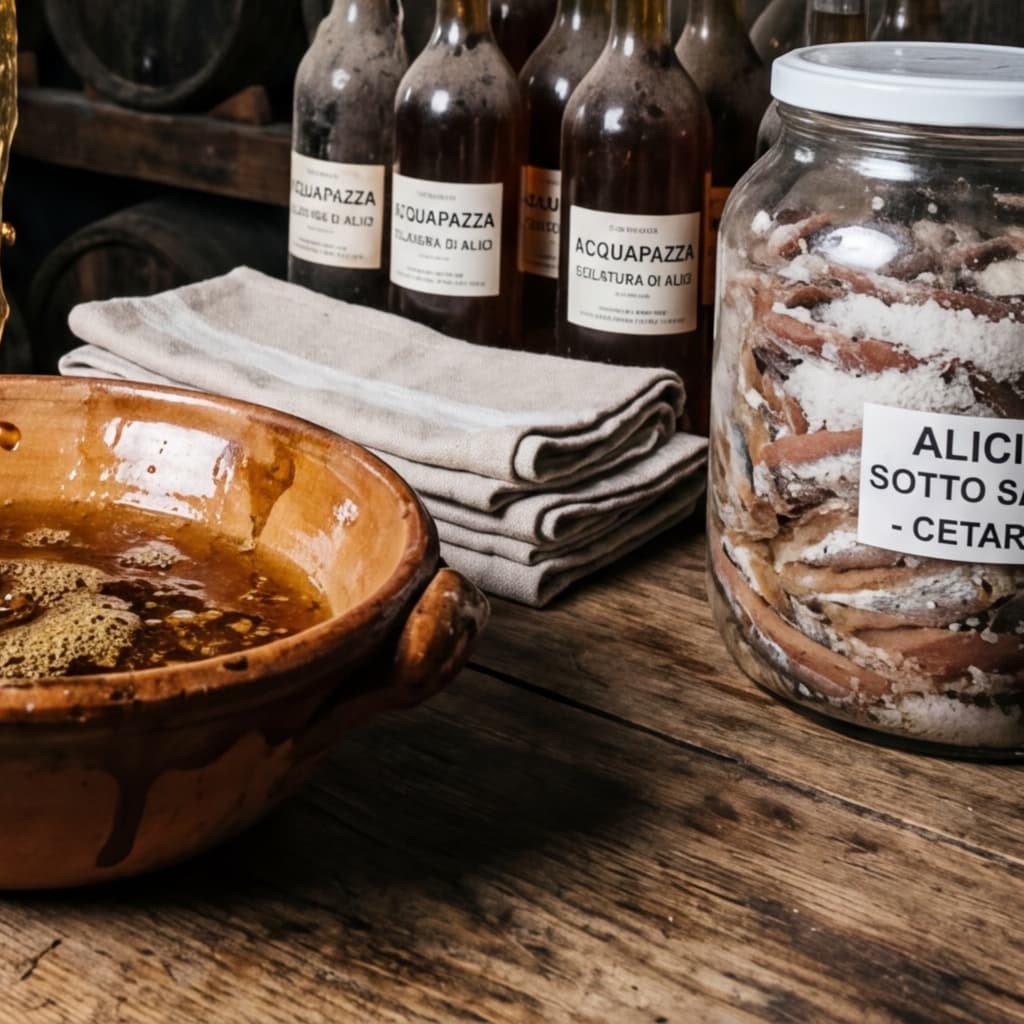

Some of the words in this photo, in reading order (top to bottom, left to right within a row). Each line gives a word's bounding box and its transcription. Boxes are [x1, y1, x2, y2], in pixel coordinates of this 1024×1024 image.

[575, 237, 694, 263] ACQUAPAZZA
[912, 426, 1023, 464] ALICI
[870, 464, 986, 503] SOTTO
[997, 479, 1024, 506] S
